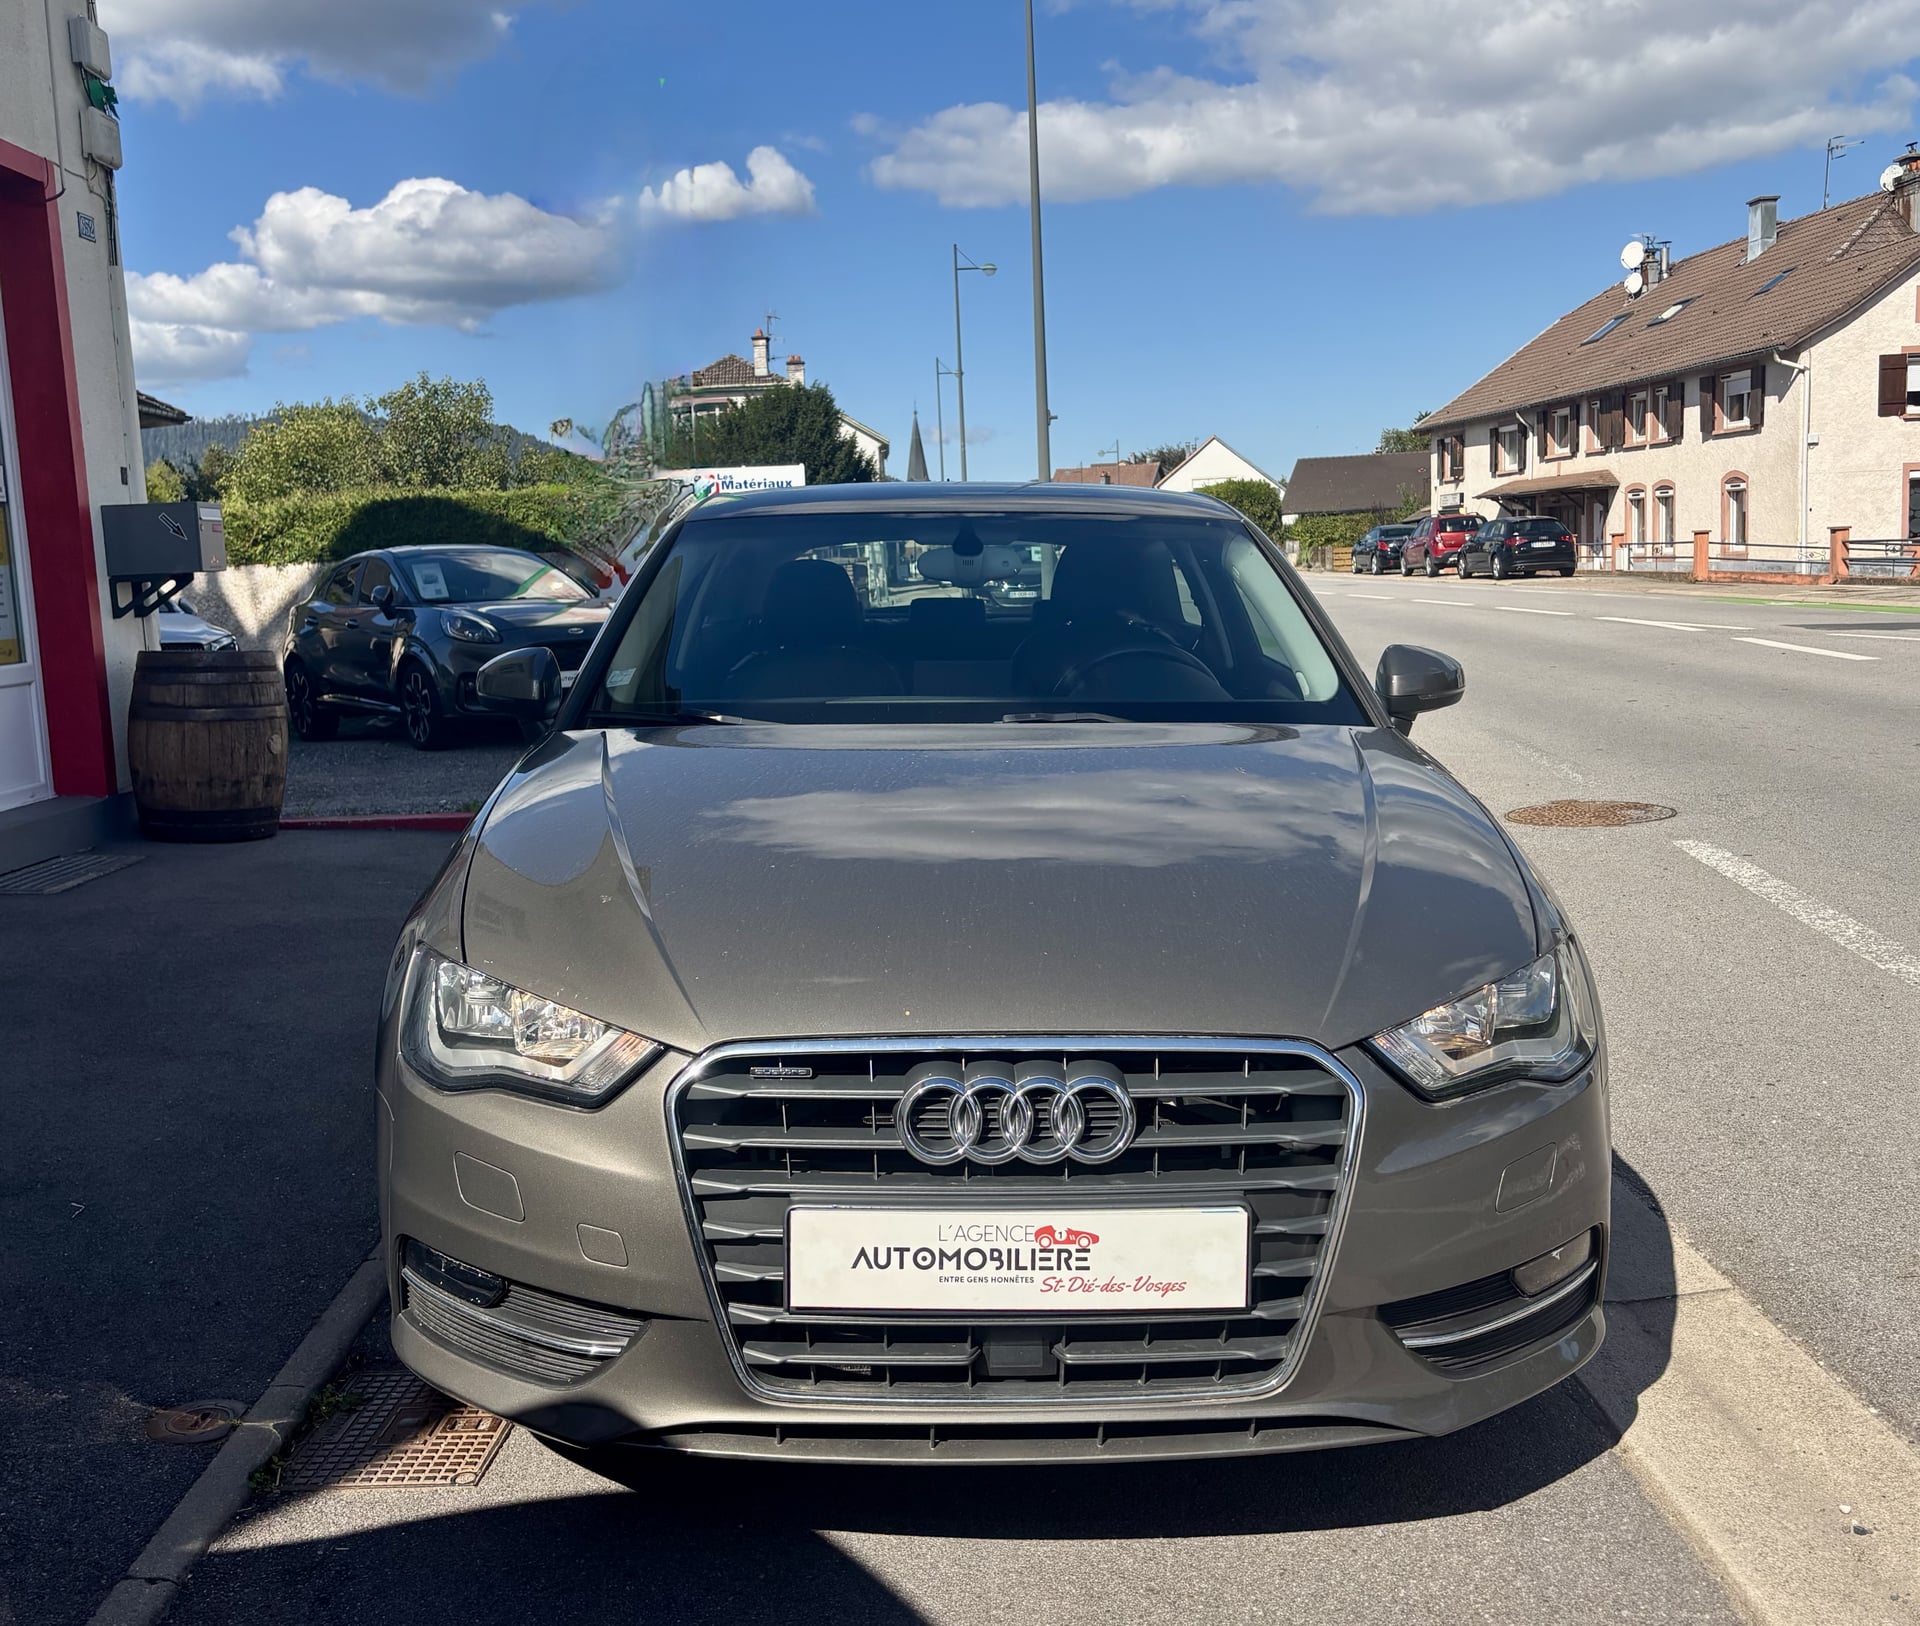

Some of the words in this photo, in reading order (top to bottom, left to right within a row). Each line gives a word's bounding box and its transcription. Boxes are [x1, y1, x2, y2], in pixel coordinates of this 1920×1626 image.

[721, 479, 793, 490] Matériaux
[938, 1224, 1035, 1243] L'AGENCE
[938, 1275, 965, 1284] ENTRE
[966, 1275, 989, 1284] GENS
[990, 1273, 1035, 1284] HONNÊTES
[1039, 1275, 1187, 1298] St-Dié-des-Vosges
